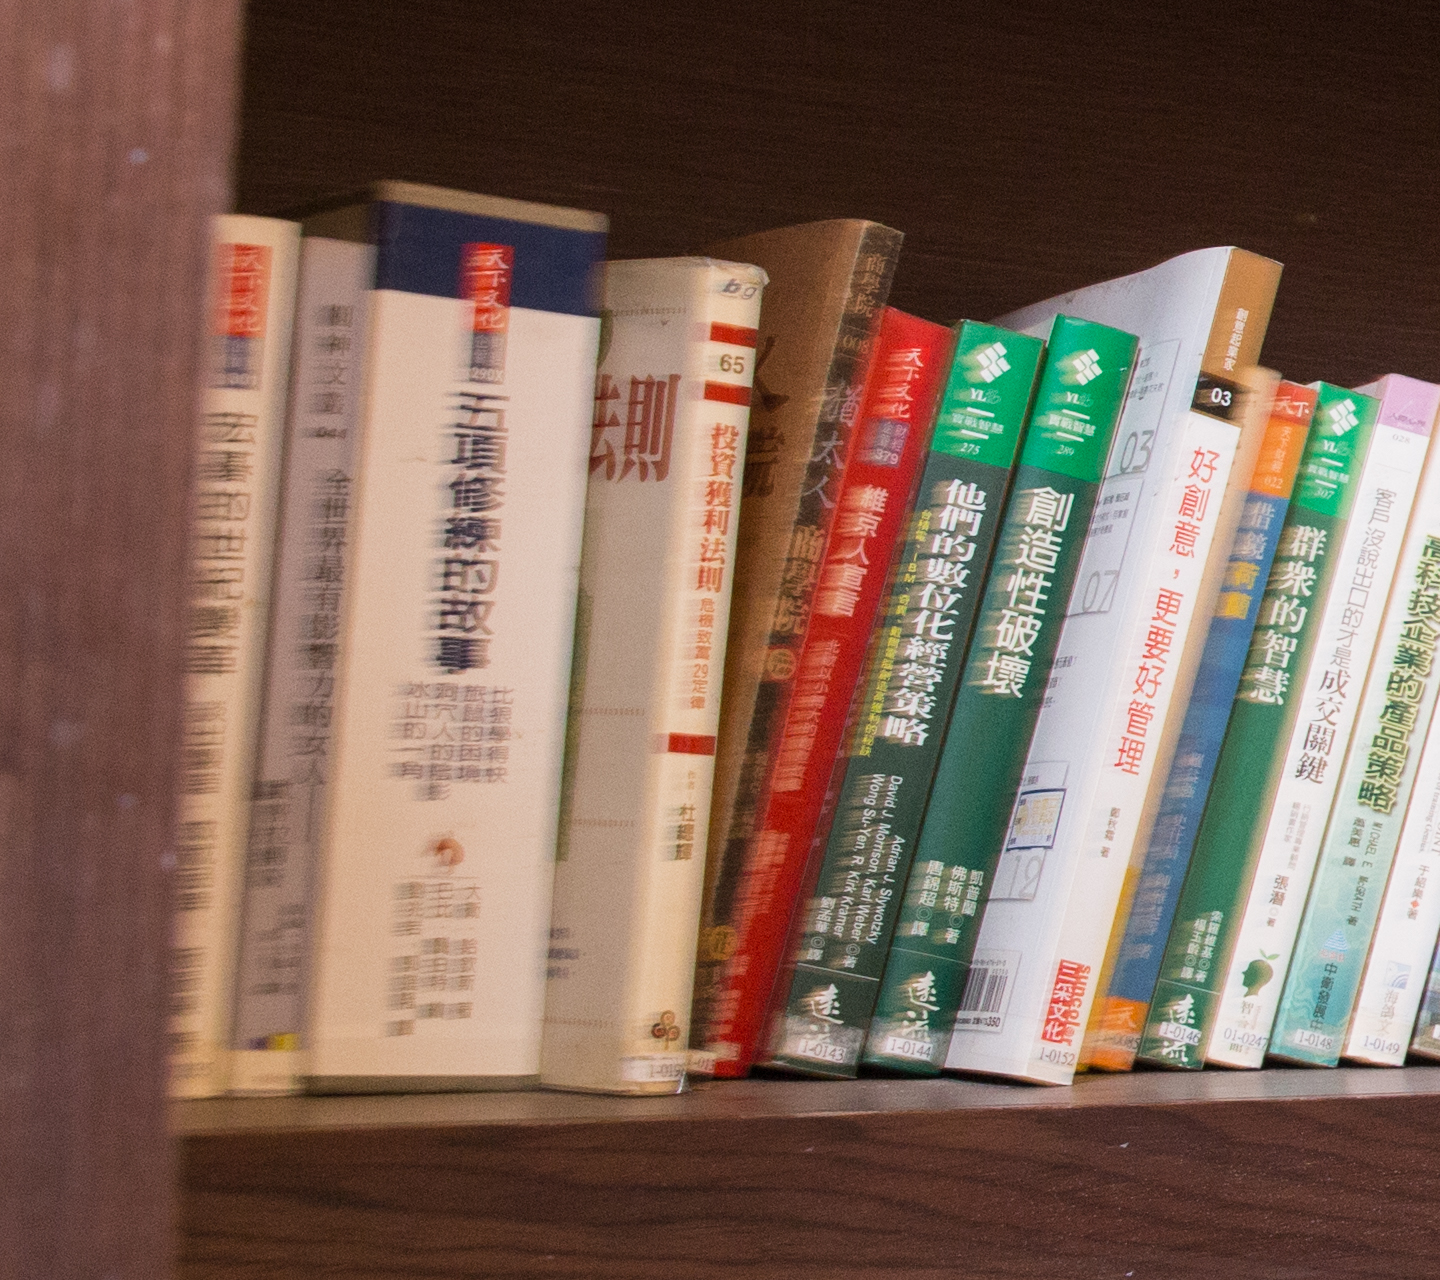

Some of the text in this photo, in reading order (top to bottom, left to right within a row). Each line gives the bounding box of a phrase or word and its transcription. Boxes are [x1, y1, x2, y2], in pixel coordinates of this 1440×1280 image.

[718, 355, 745, 374] 65
[890, 346, 925, 421] 天下文化
[694, 422, 742, 594] 投資獲利法則
[983, 486, 1075, 700] 創造性破壞
[882, 477, 991, 748] 他們的數位化經營策略
[1249, 524, 1328, 706] 群眾的智慧
[1294, 486, 1398, 787] 客戶沒說出口的才是成交關鍵
[864, 773, 884, 803] Wong
[887, 775, 902, 807] David
[866, 822, 890, 872] Morrison,
[885, 835, 904, 871] Adrian
[843, 871, 857, 893] Kirk
[861, 877, 877, 900] Karl
[833, 896, 851, 937] Kramer
[851, 904, 869, 940] Weber
[867, 888, 892, 945] Slywotzky
[1298, 1030, 1333, 1050] 1-0148
[1363, 1036, 1400, 1054] 1-0149
